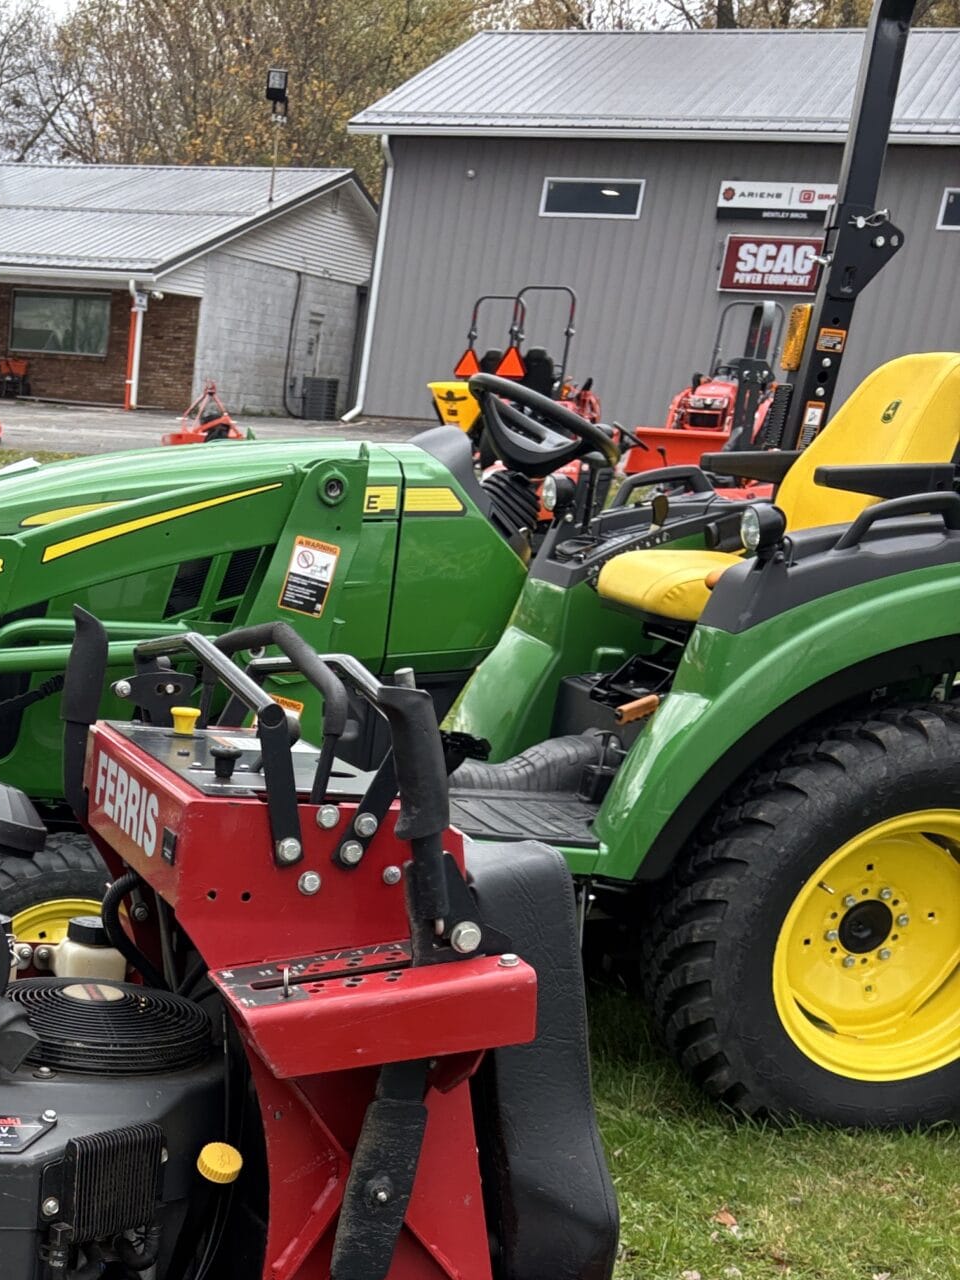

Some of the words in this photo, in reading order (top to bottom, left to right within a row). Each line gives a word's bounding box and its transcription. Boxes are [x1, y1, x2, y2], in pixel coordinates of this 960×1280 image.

[738, 191, 783, 199] ARIENS
[735, 243, 817, 274] SCAG
[733, 272, 762, 285] POWER
[763, 273, 811, 287] EQUIPMENT
[95, 750, 159, 858] FERRIS
